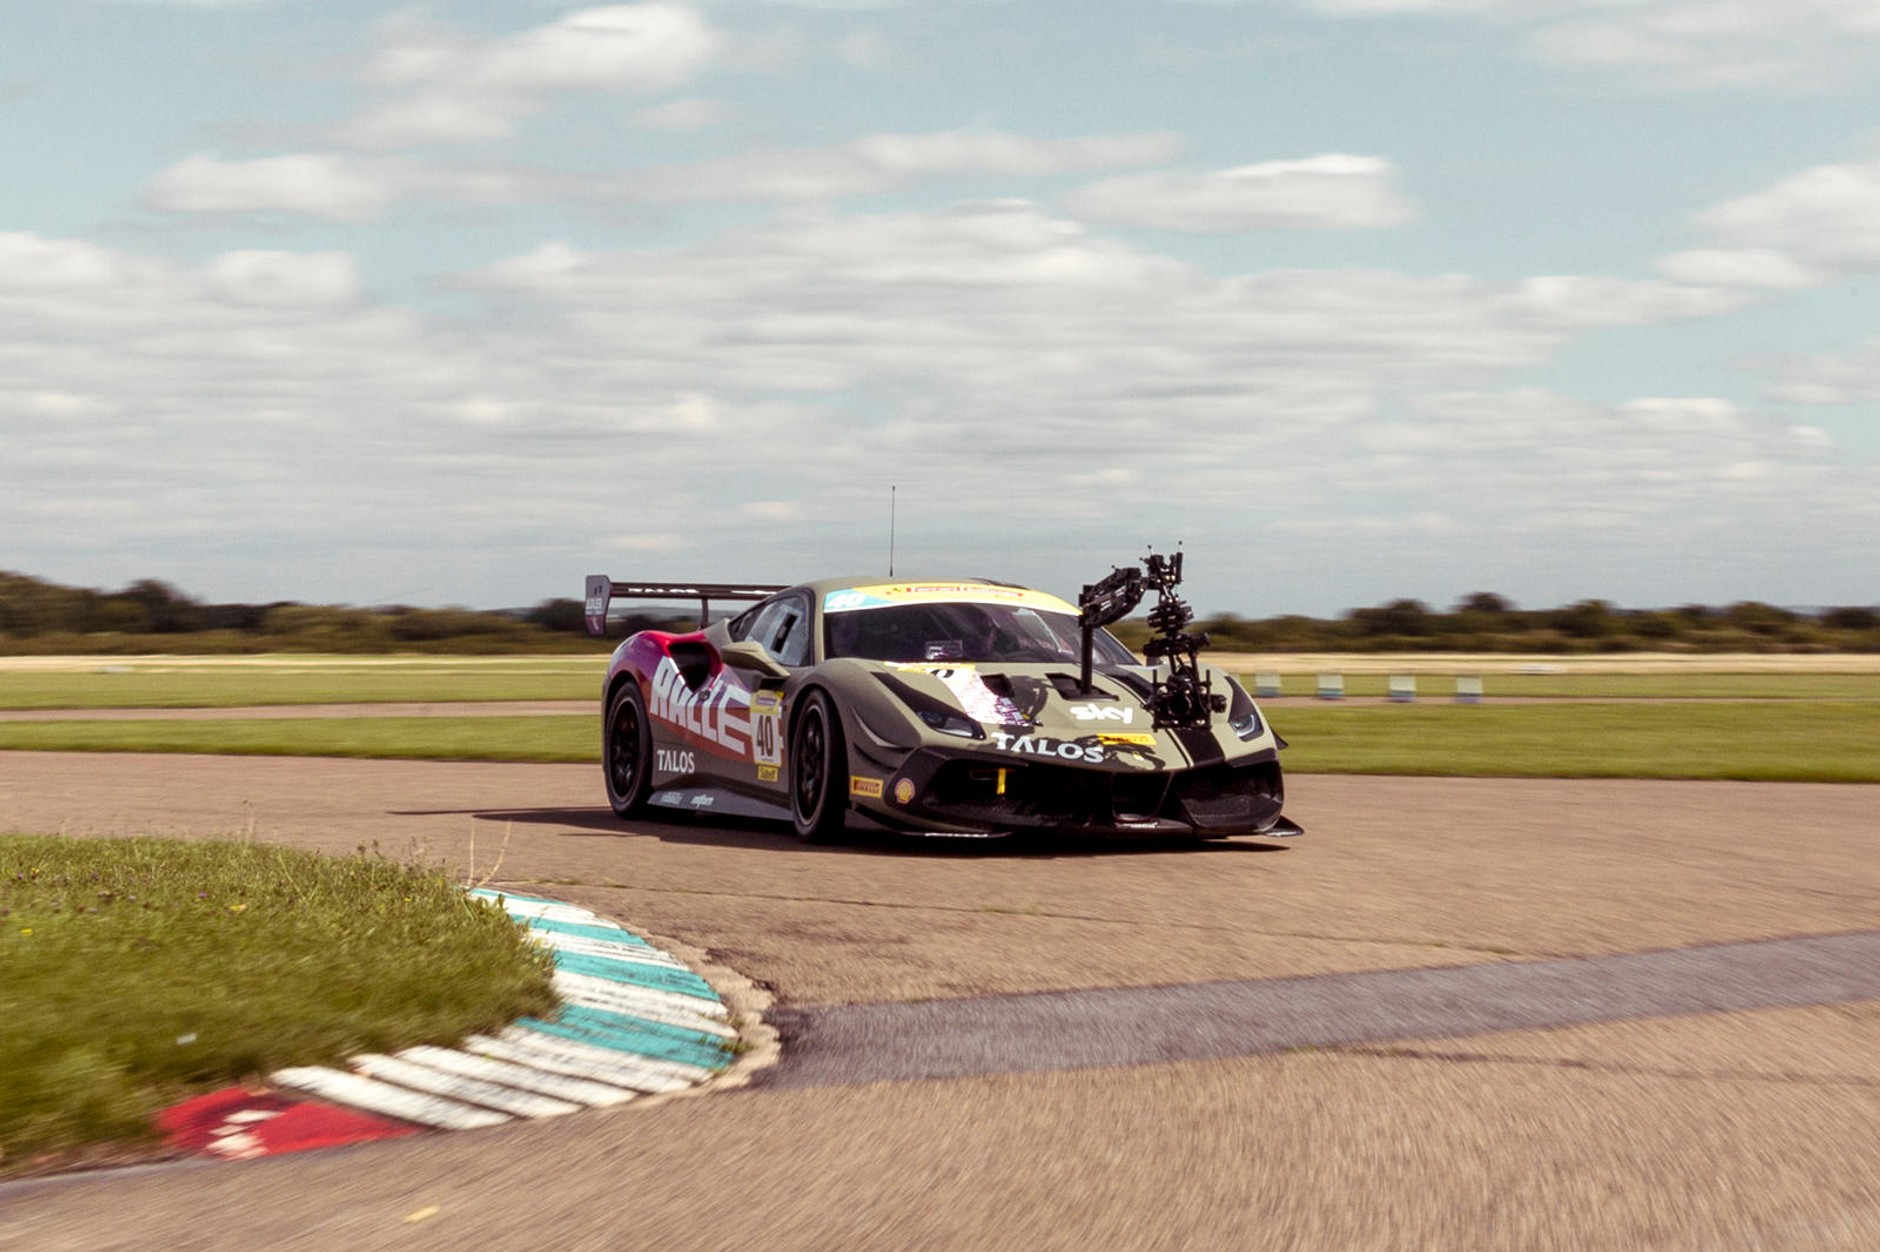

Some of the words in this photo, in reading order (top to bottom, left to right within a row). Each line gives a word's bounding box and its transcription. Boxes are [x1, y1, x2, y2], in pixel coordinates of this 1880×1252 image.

[1069, 702, 1134, 725] sky
[757, 714, 774, 757] 40
[990, 732, 1105, 763] TALOS
[656, 749, 696, 773] TALOS
